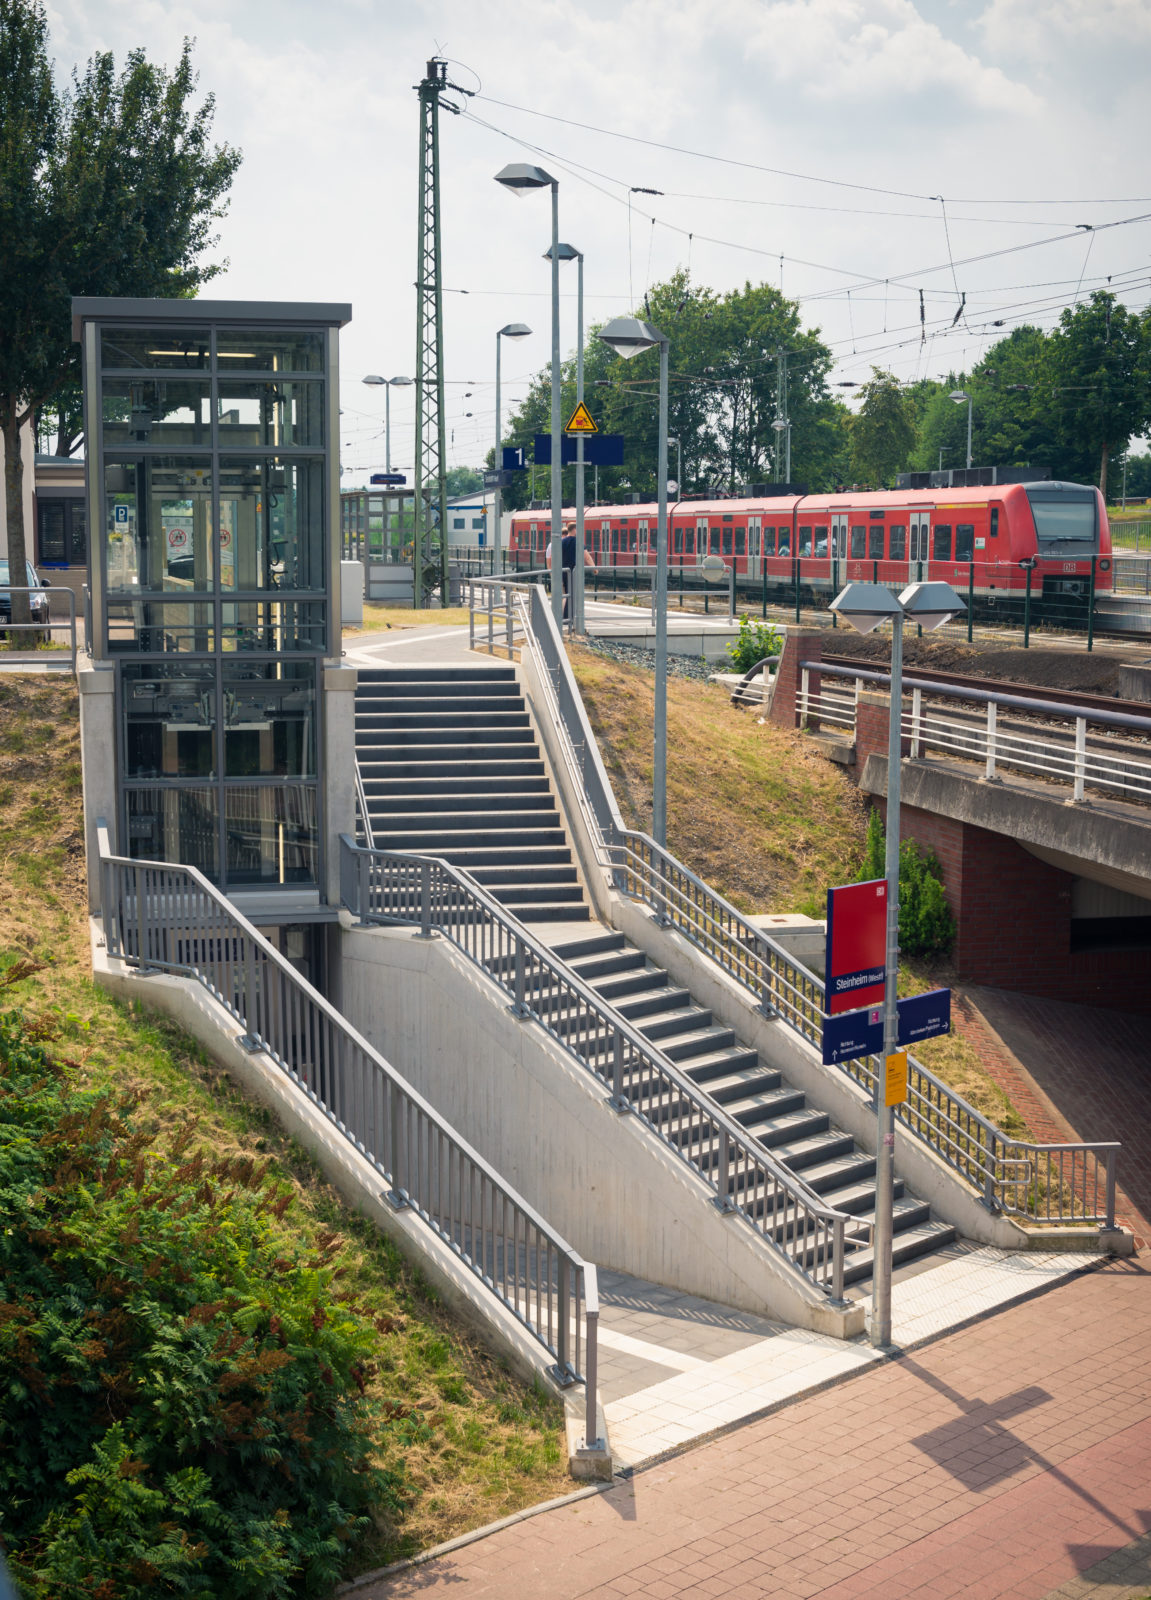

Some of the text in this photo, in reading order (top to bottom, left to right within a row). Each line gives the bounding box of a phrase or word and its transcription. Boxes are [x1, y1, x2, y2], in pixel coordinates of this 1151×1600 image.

[515, 448, 523, 466] 1
[118, 508, 126, 521] P
[836, 973, 868, 990] Steinheim
